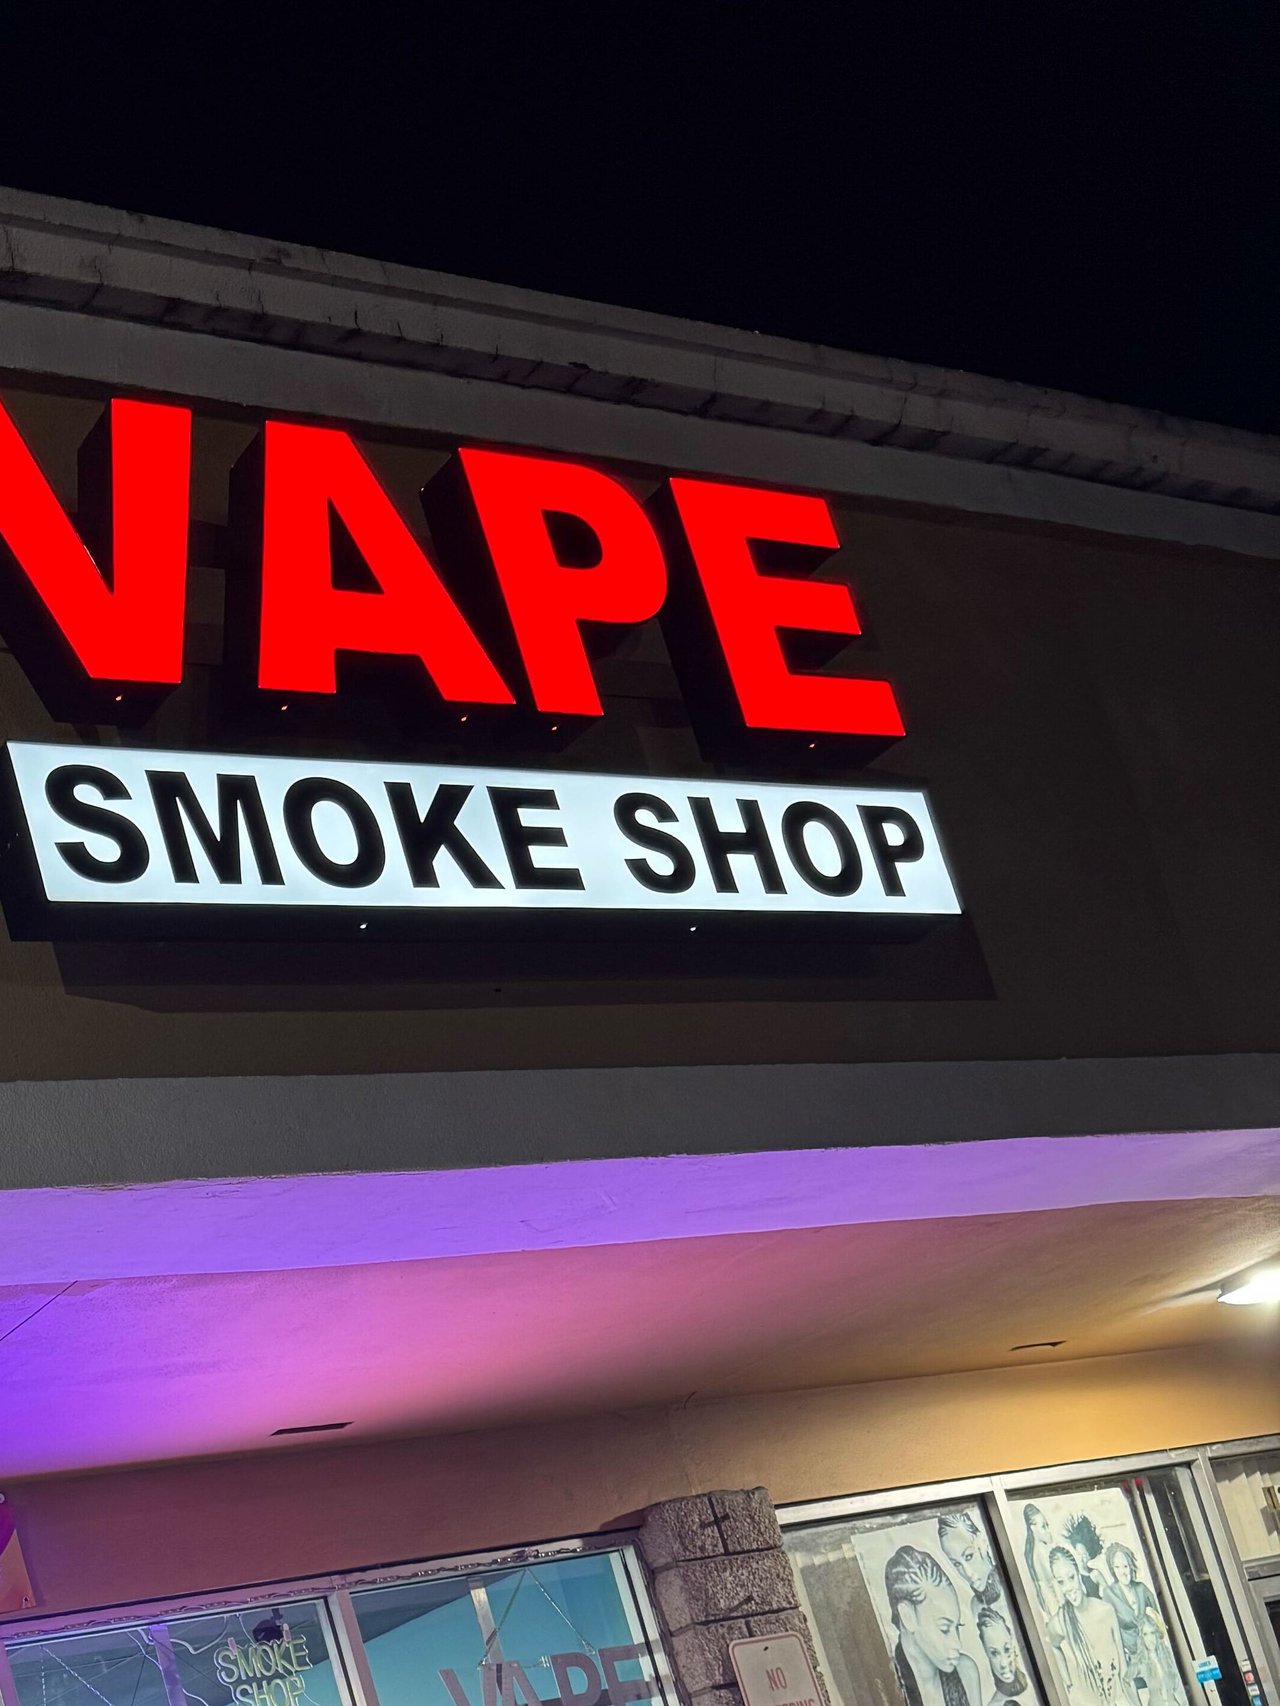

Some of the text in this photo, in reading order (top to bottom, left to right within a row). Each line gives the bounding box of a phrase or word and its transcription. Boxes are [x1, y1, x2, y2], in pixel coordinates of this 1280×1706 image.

[44, 763, 925, 899] SMOKE SHOP
[218, 1639, 311, 1682] SMOKE
[765, 1666, 788, 1692] NO
